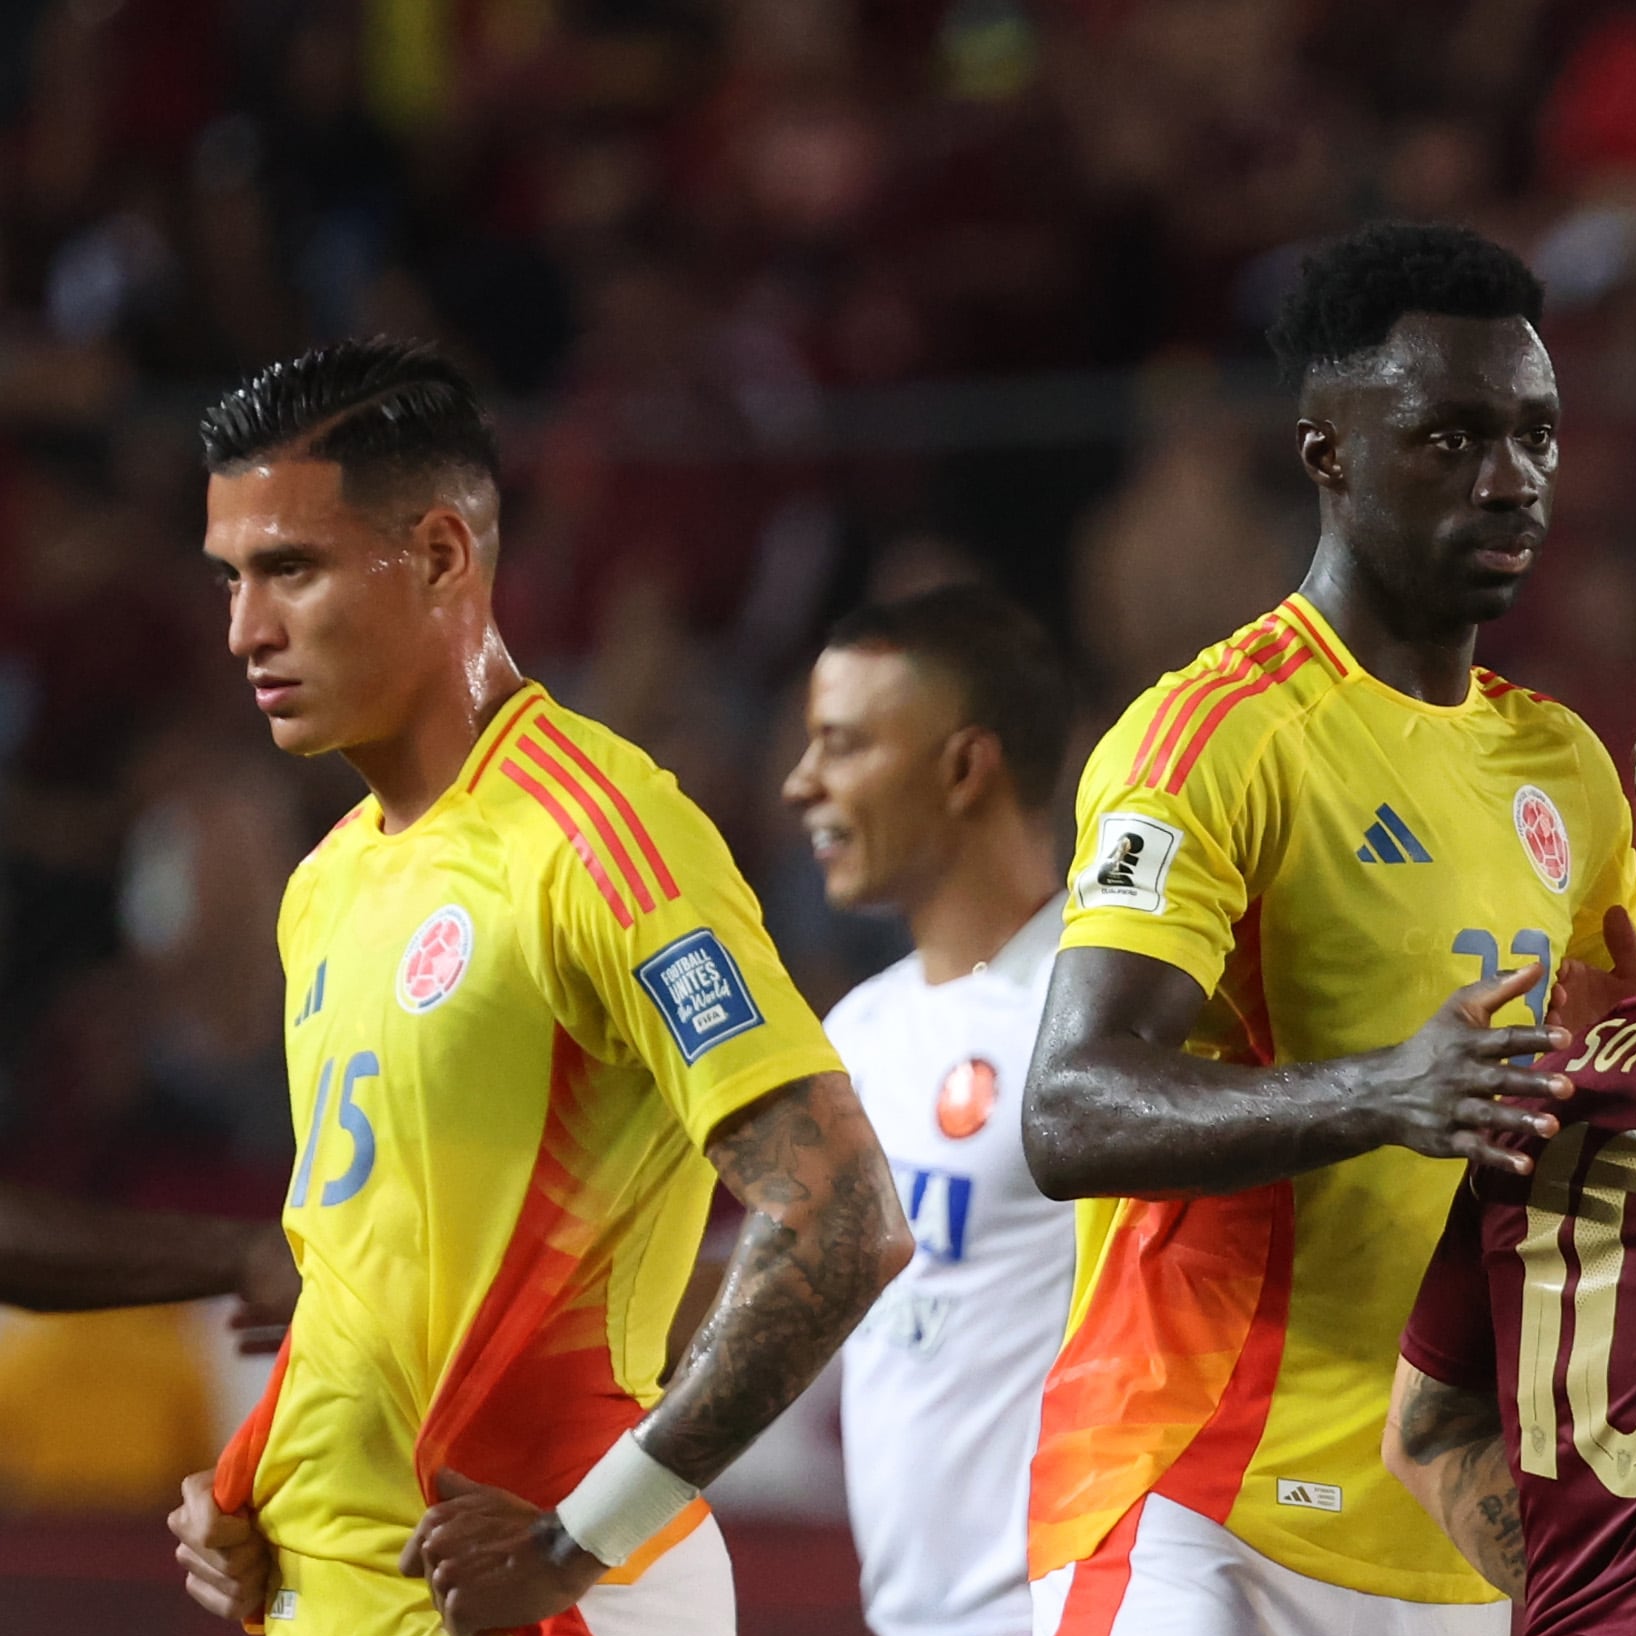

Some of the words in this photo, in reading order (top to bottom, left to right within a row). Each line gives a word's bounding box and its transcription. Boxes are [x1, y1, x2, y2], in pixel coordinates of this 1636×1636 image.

[660, 947, 712, 987] FOOTBALL
[668, 961, 721, 1005] UNITES
[697, 1010, 722, 1028] FIFA
[289, 1050, 381, 1208] 15
